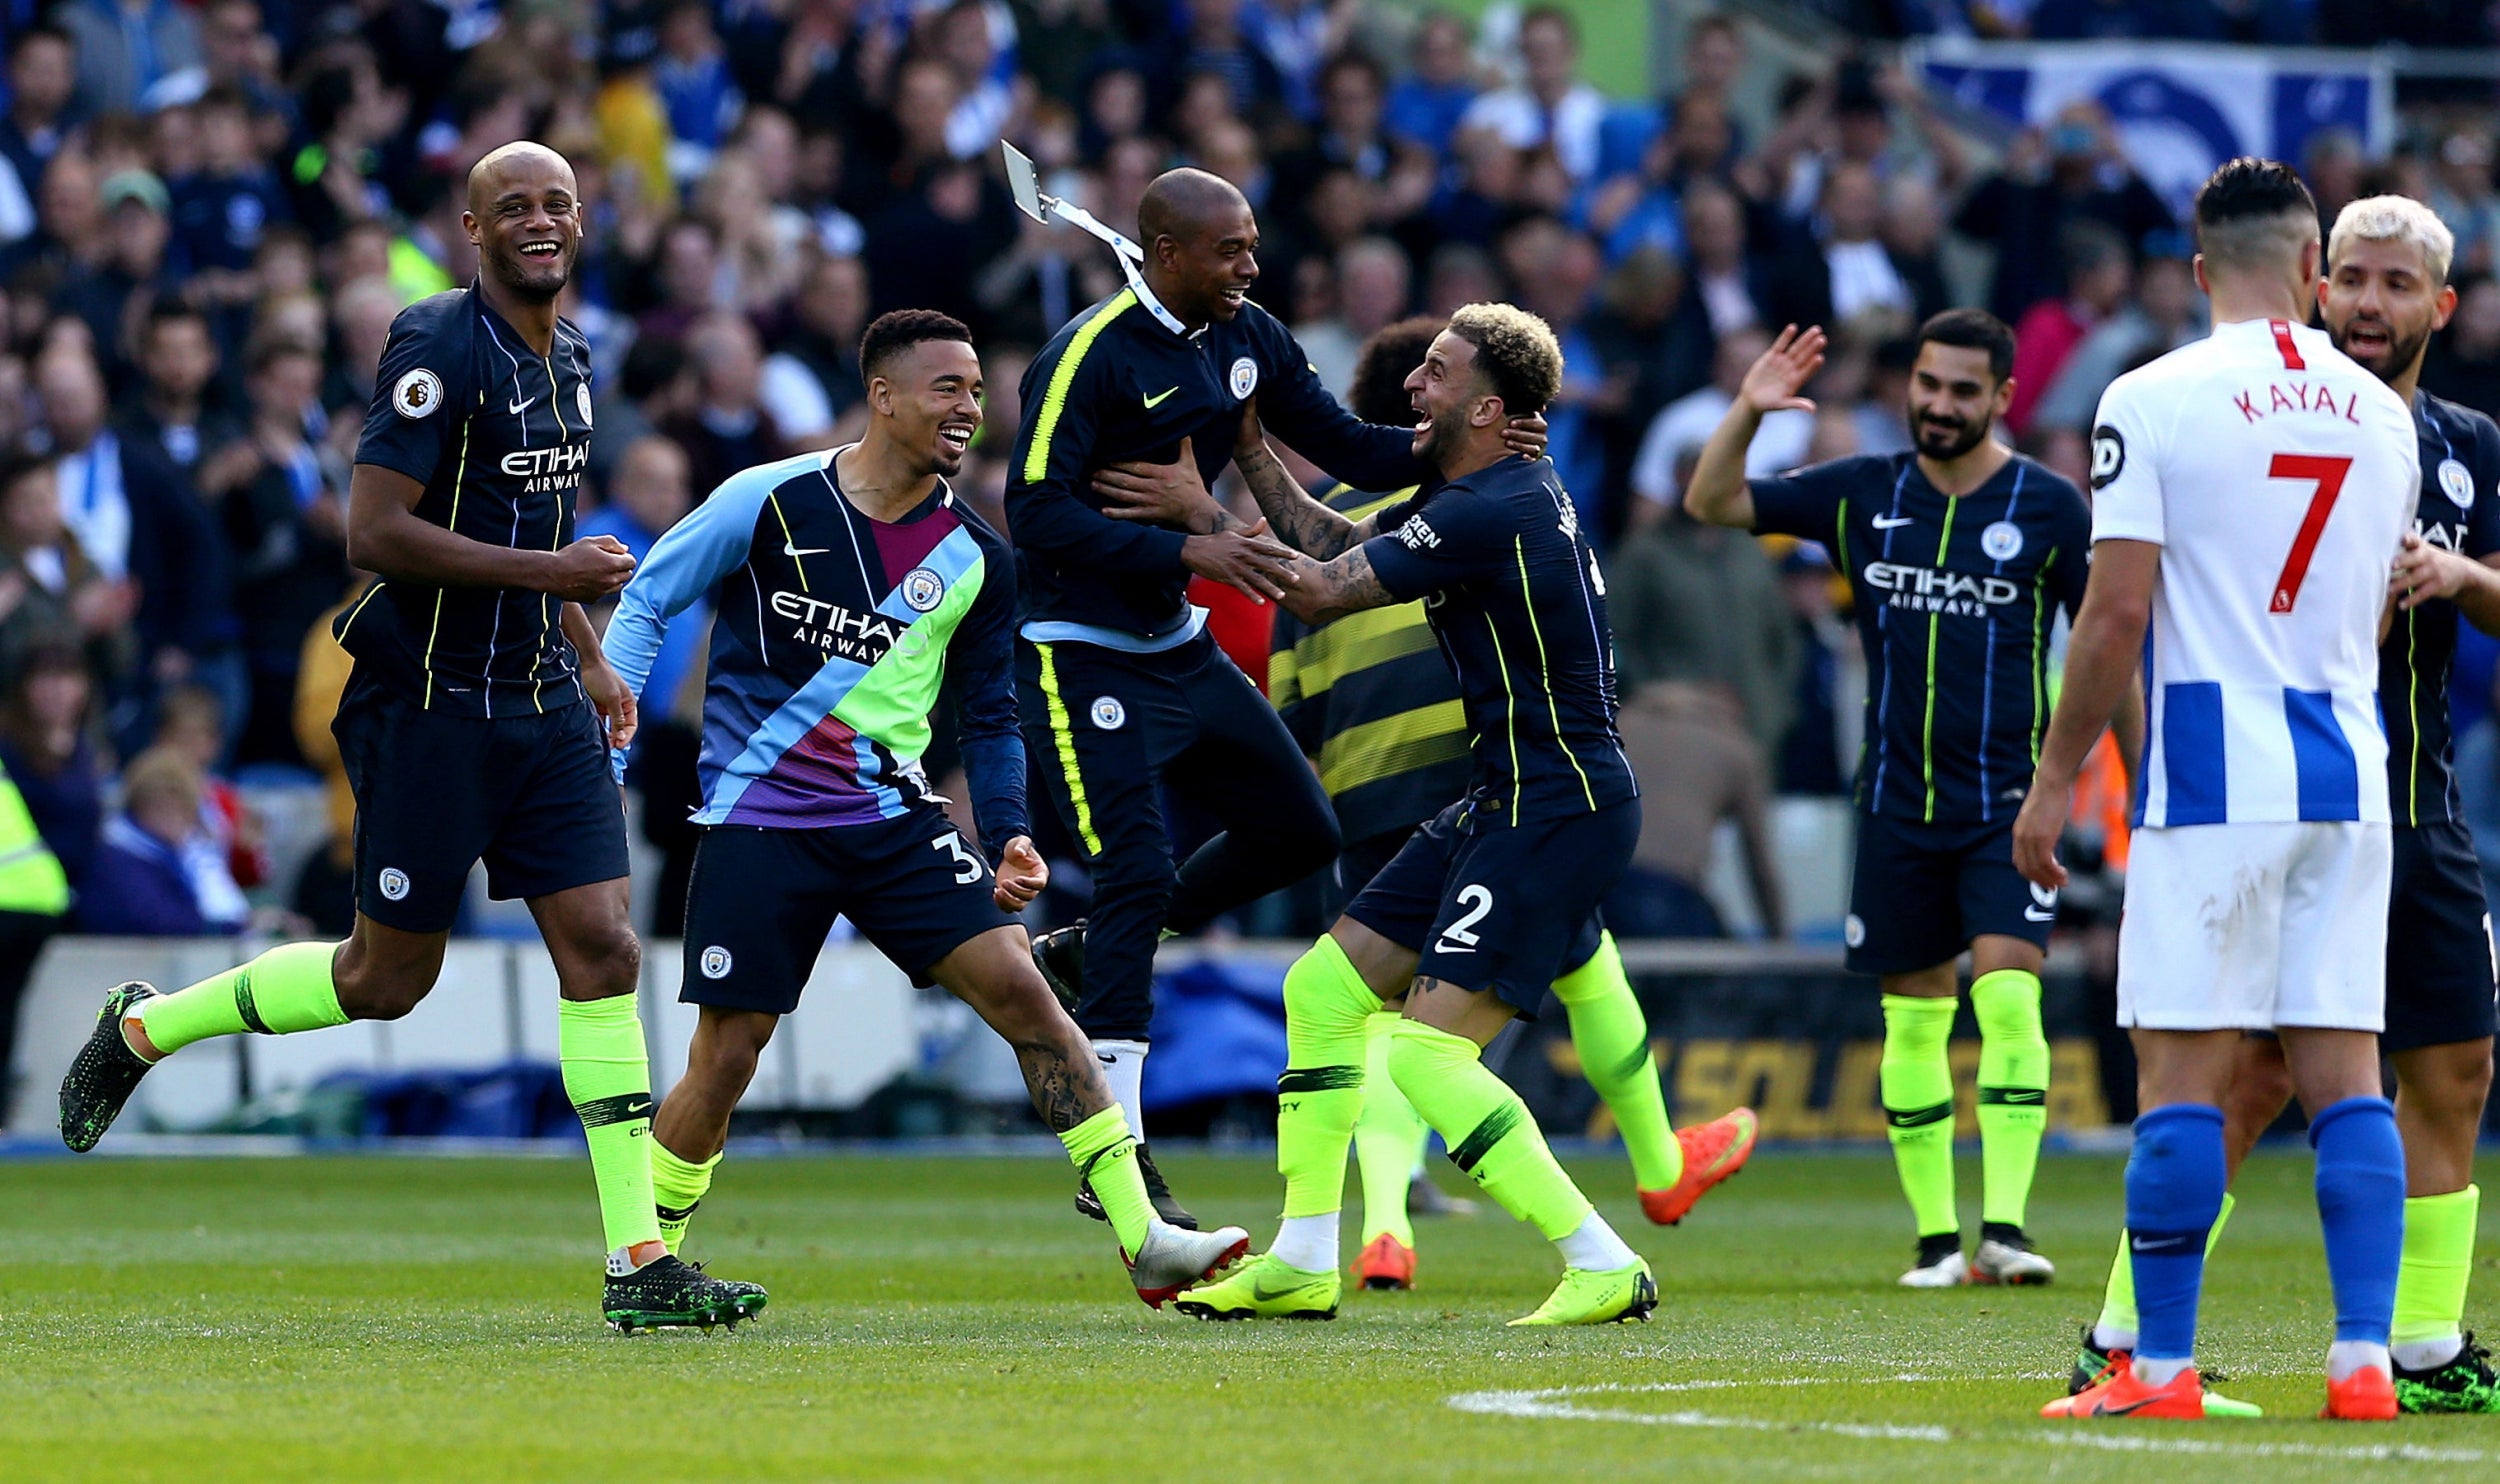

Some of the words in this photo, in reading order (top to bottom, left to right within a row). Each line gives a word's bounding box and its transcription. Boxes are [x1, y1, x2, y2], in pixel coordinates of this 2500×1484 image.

[2233, 380, 2361, 425] KAYAL
[500, 439, 590, 476] ETIHA
[523, 472, 580, 493] AIRWAY
[2266, 452, 2355, 615] 7
[1863, 560, 2019, 606] ETIHAD
[1887, 591, 1988, 618] AIRWAYS
[931, 828, 996, 891] 3
[1441, 883, 1494, 947] 2
[1280, 1101, 1302, 1113] TY
[629, 1126, 650, 1138] CIT
[1112, 1144, 1132, 1158] CIT
